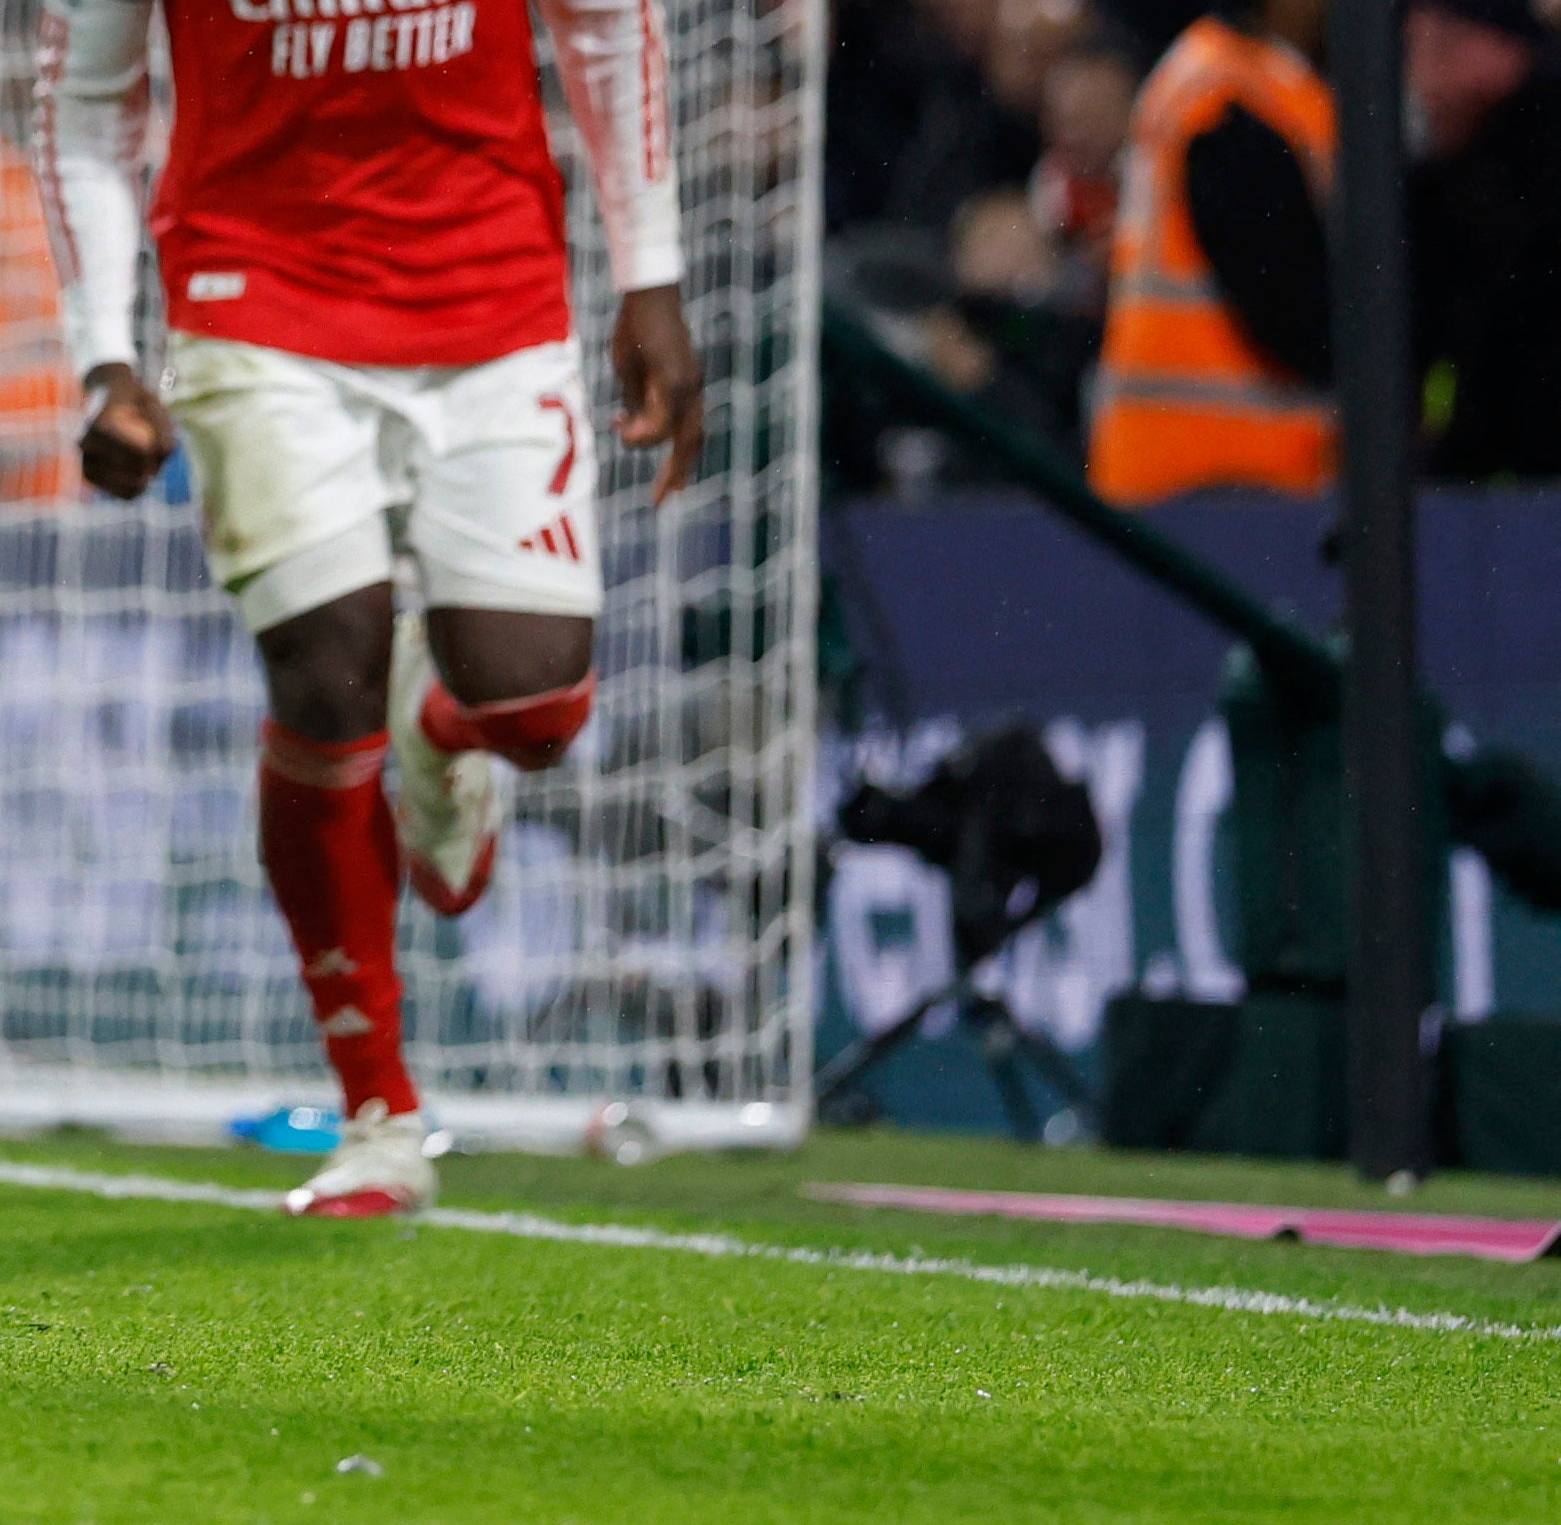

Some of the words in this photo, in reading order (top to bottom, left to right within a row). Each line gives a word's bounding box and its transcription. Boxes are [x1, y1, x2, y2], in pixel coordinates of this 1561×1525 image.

[271, 21, 336, 79] FLY
[343, 0, 477, 72] BETTER
[537, 392, 577, 497] 7
